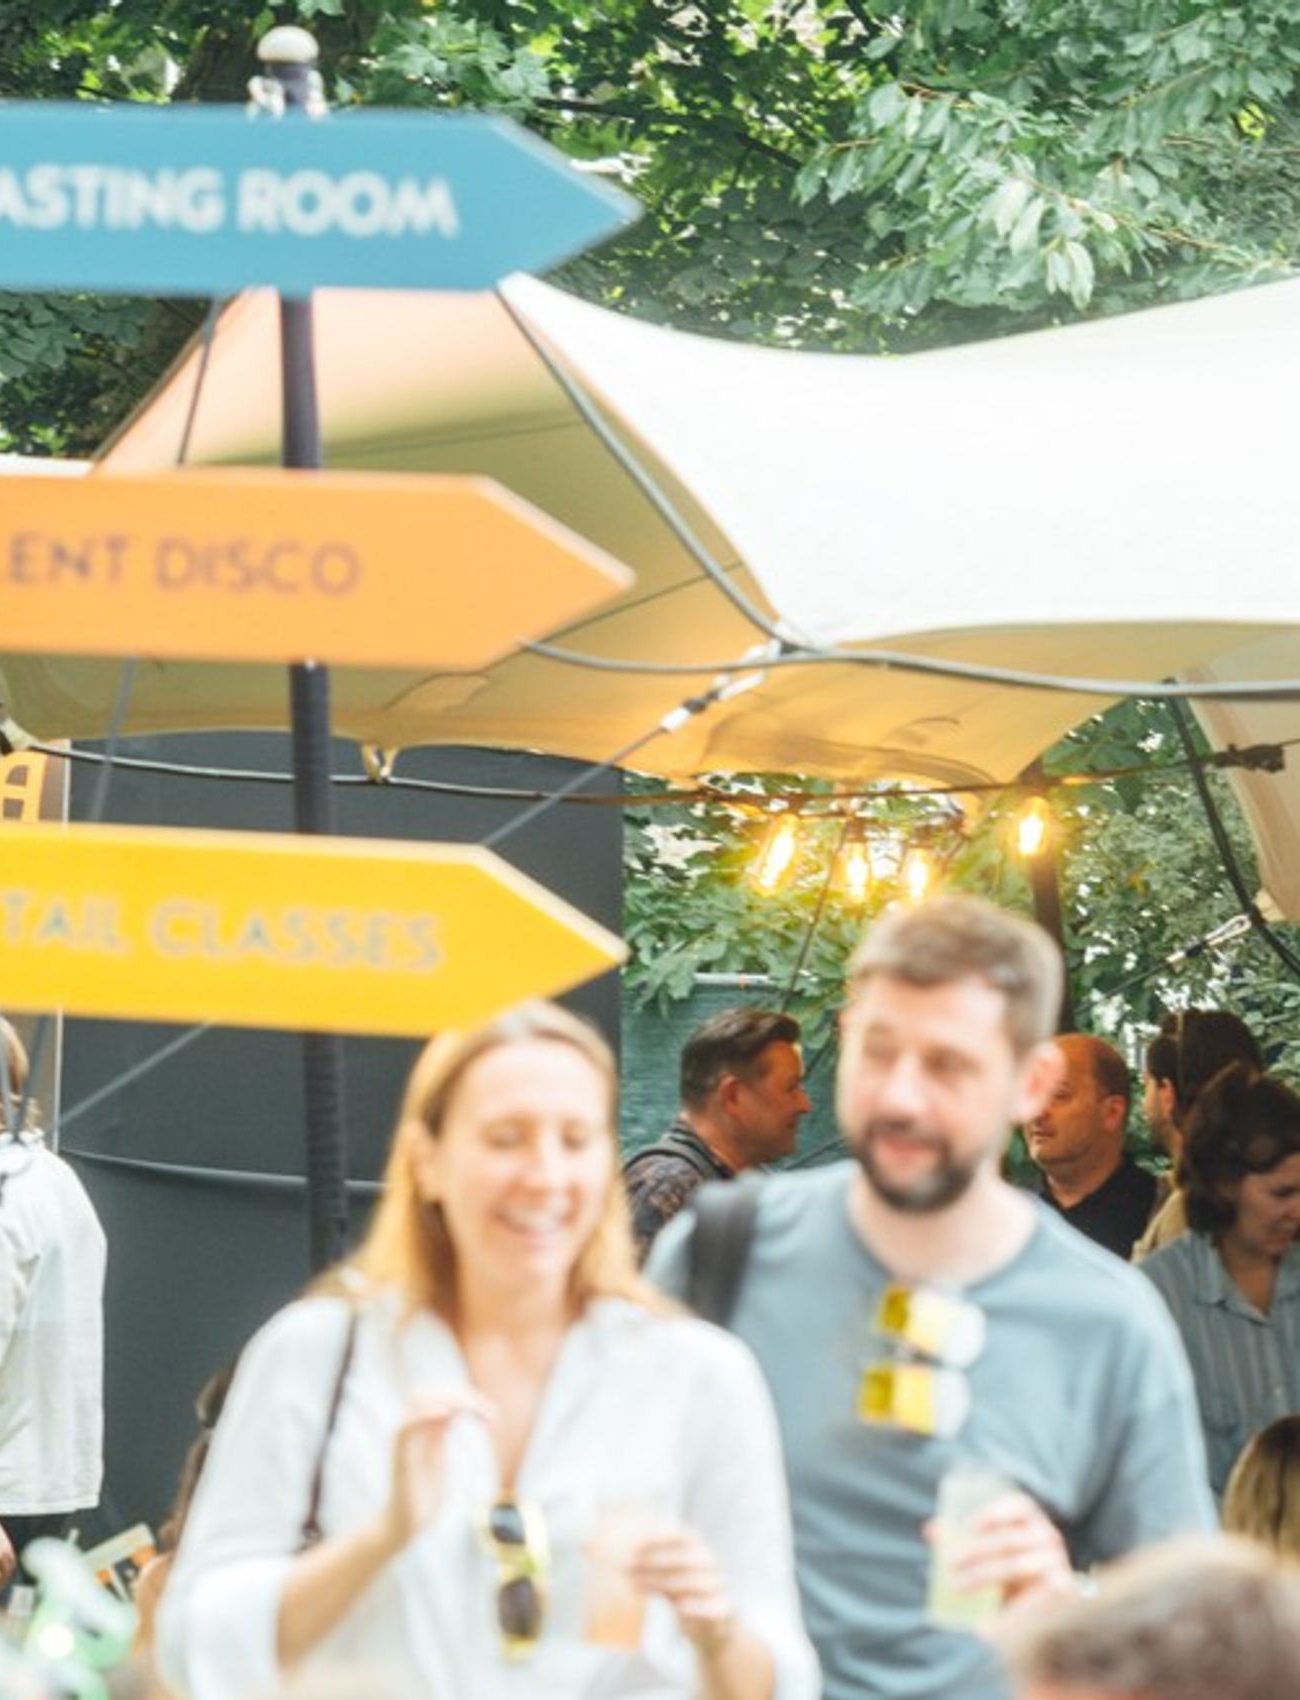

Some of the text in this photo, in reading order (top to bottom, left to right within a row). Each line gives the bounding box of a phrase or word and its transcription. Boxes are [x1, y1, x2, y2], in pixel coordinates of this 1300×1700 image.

[237, 172, 459, 238] ROOM
[155, 543, 361, 596] DISCO
[151, 897, 444, 969] CLASSES
